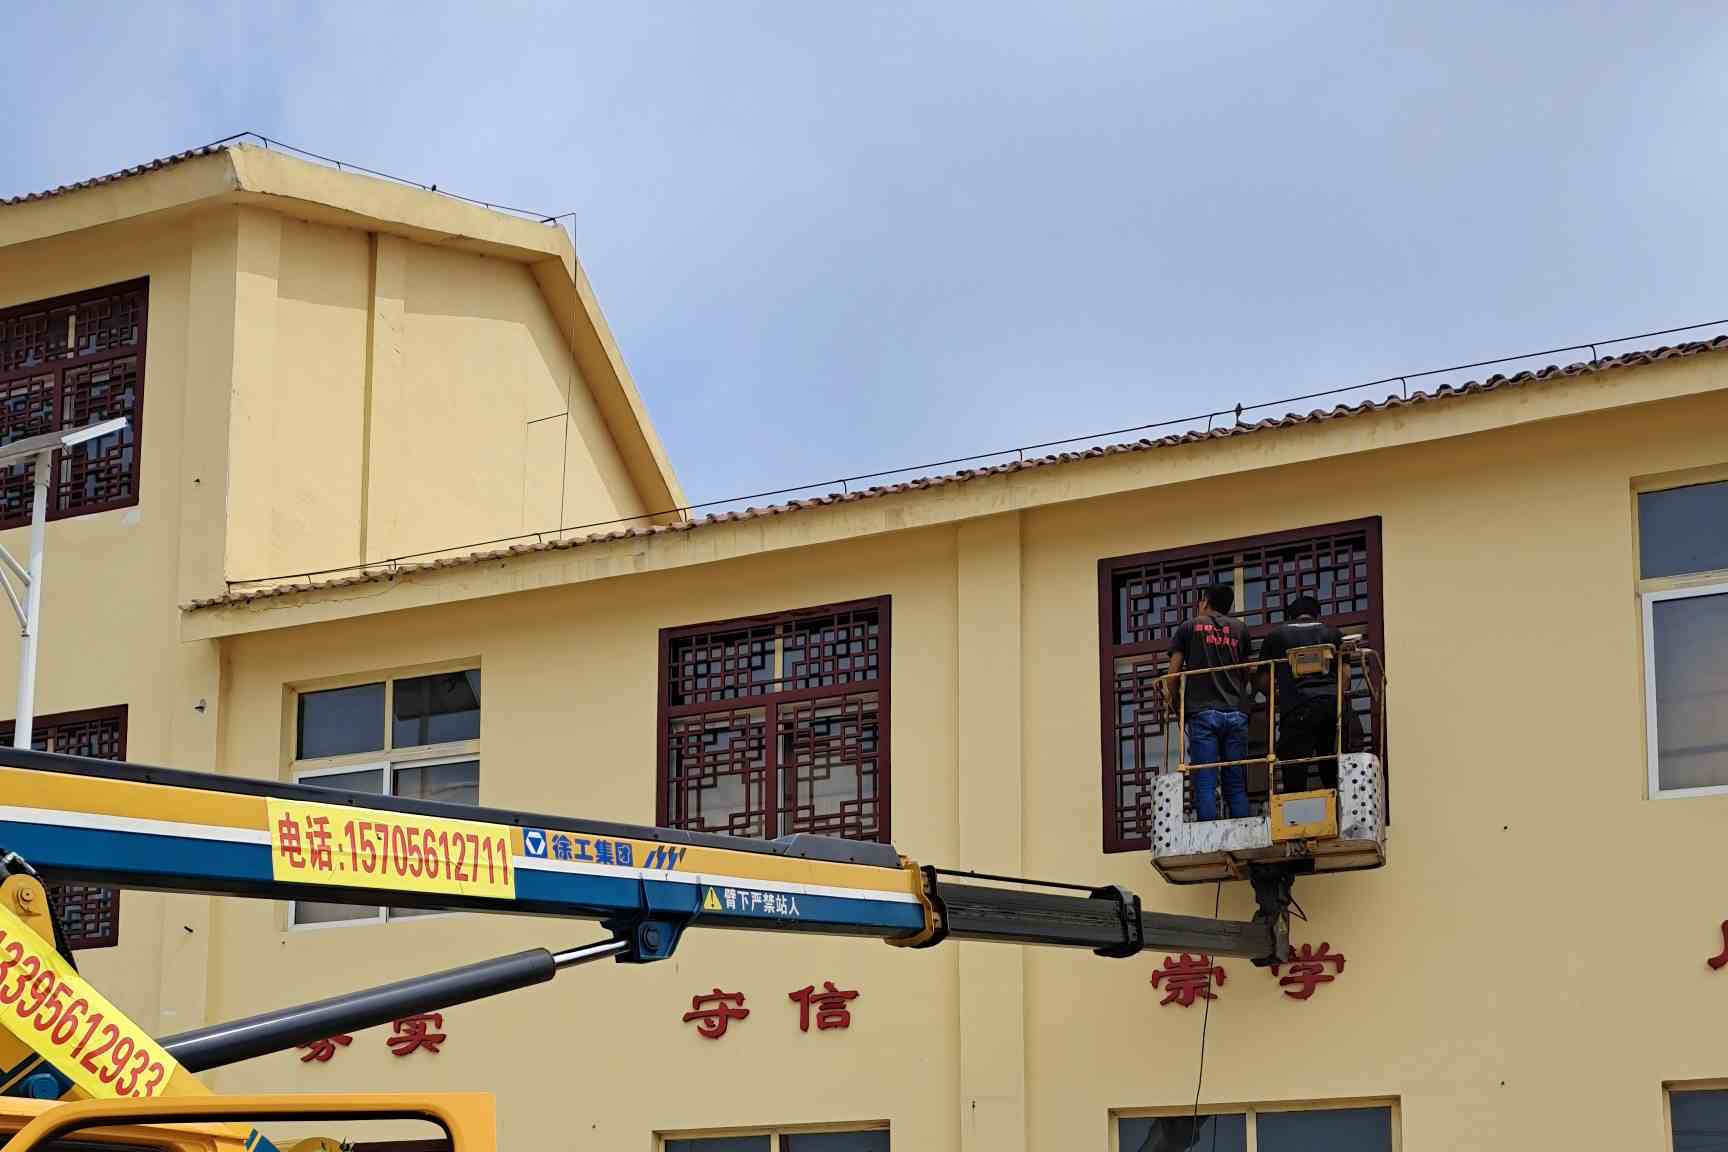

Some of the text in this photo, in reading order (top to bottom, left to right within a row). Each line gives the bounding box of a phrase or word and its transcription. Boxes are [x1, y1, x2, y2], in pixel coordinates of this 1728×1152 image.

[551, 834, 634, 868] 徐工集团
[723, 887, 801, 916] 臂下严禁站人
[0, 930, 165, 1098] 3395612933
[682, 980, 860, 1040] 守信
[1150, 942, 1347, 1008] 崇学
